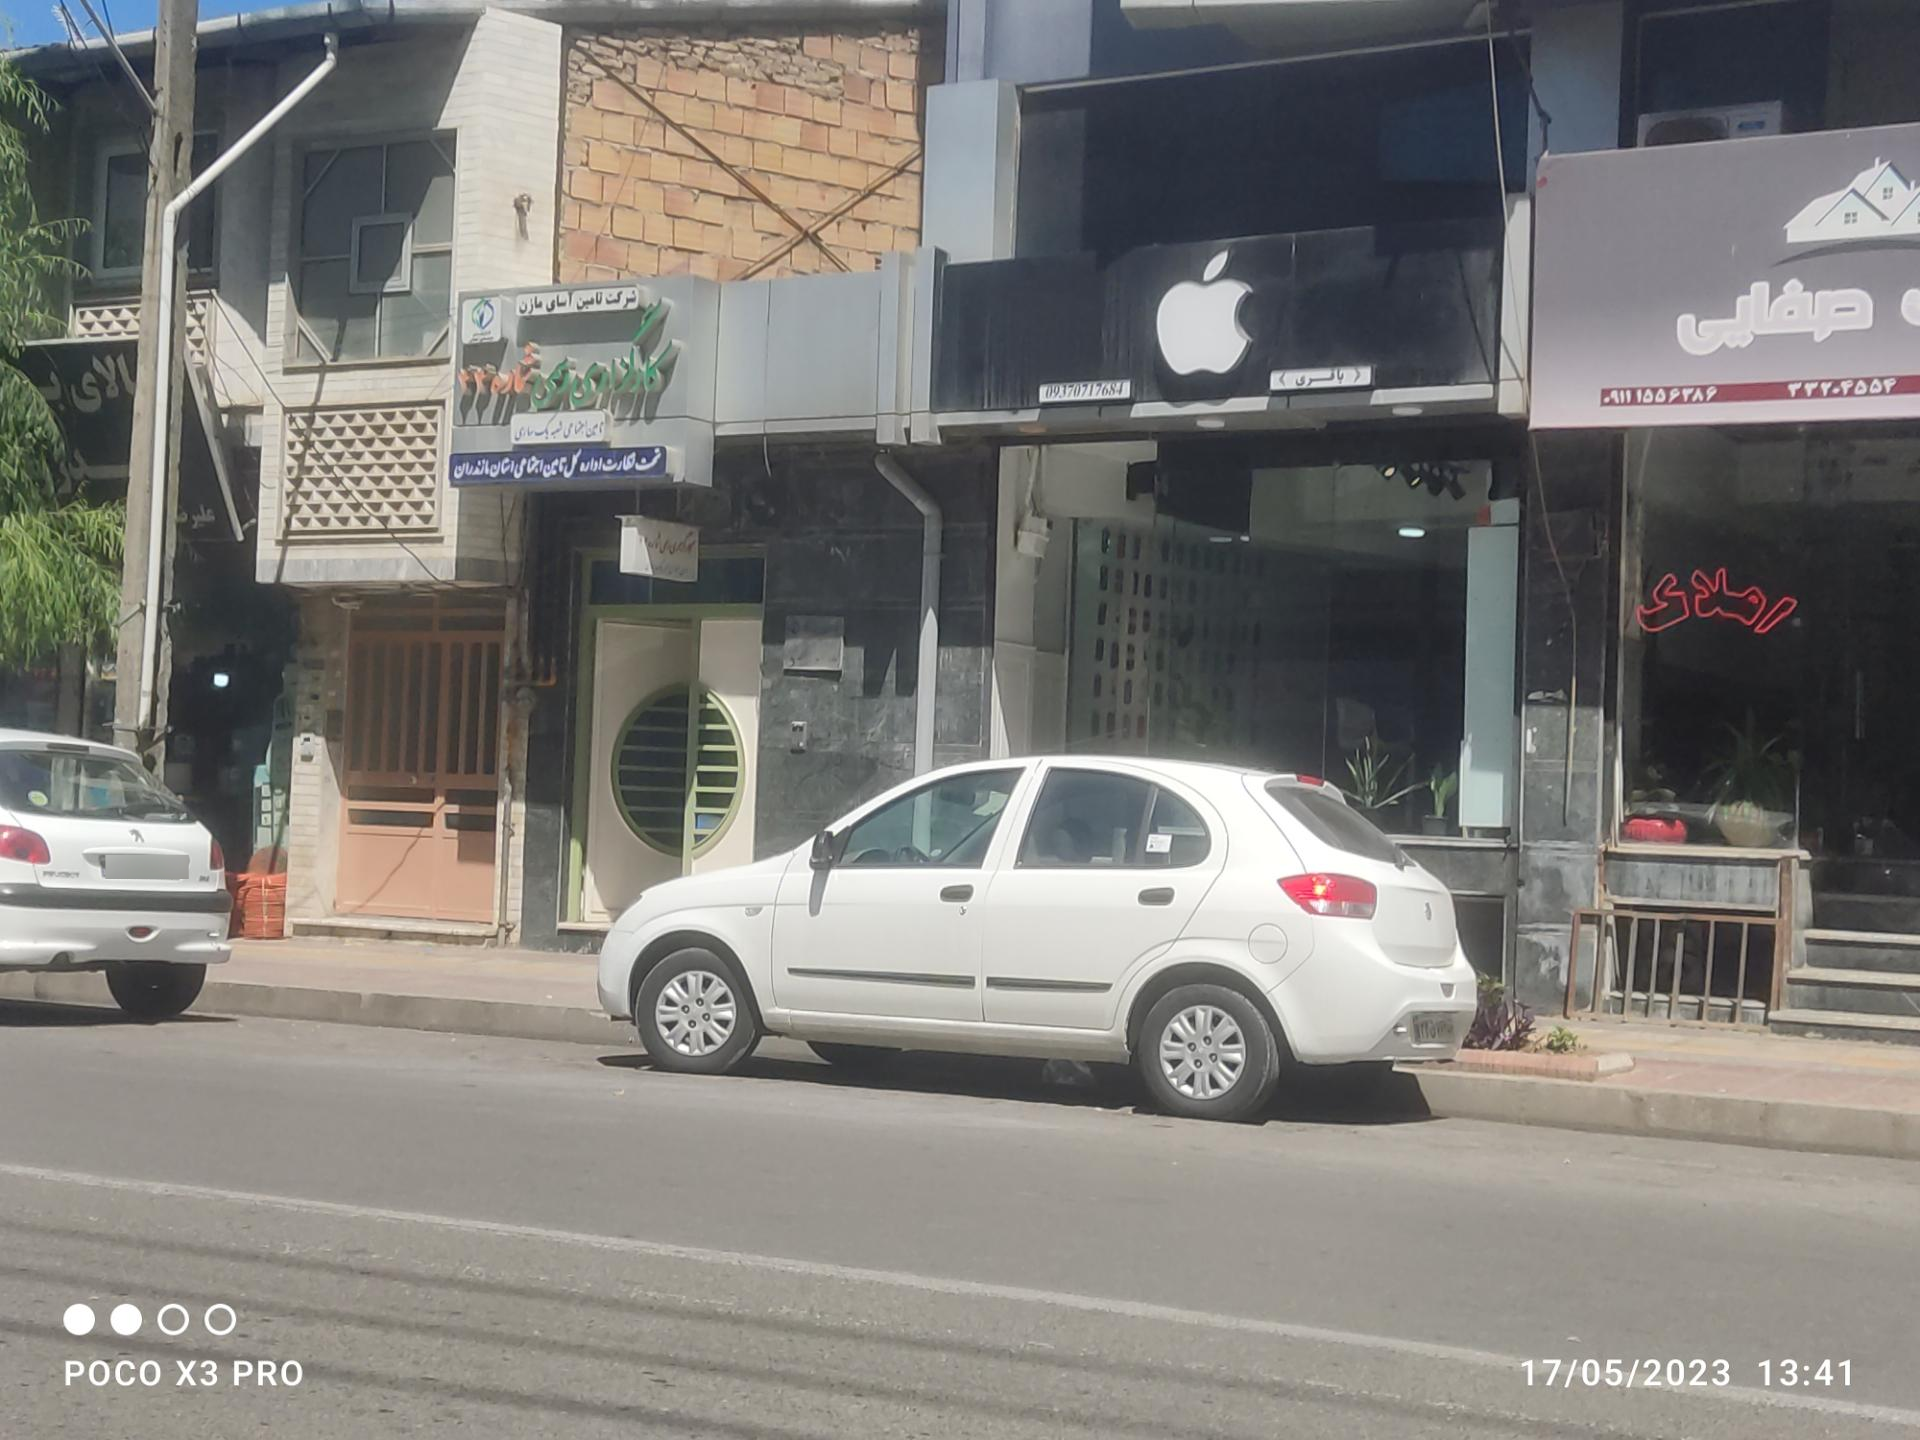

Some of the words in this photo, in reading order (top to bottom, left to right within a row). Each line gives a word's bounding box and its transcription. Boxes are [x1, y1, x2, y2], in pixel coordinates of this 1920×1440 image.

[518, 296, 543, 315] مازن
[576, 292, 603, 311] تامین
[606, 290, 638, 310] شرکت
[1676, 278, 1873, 355] صفایی
[70, 353, 137, 413] الای
[1294, 368, 1345, 387] باقری
[1787, 378, 1897, 398] ۳۳۲۰۴۵۵۴
[1045, 382, 1124, 399] 09370717684
[454, 457, 491, 479] مازندران
[489, 456, 514, 478] استان
[513, 455, 544, 479] اجتماعی
[543, 455, 565, 478] تامین
[563, 448, 582, 478] کل
[580, 456, 603, 472] اداره
[602, 451, 637, 472] نظارت
[635, 448, 663, 471] تحت
